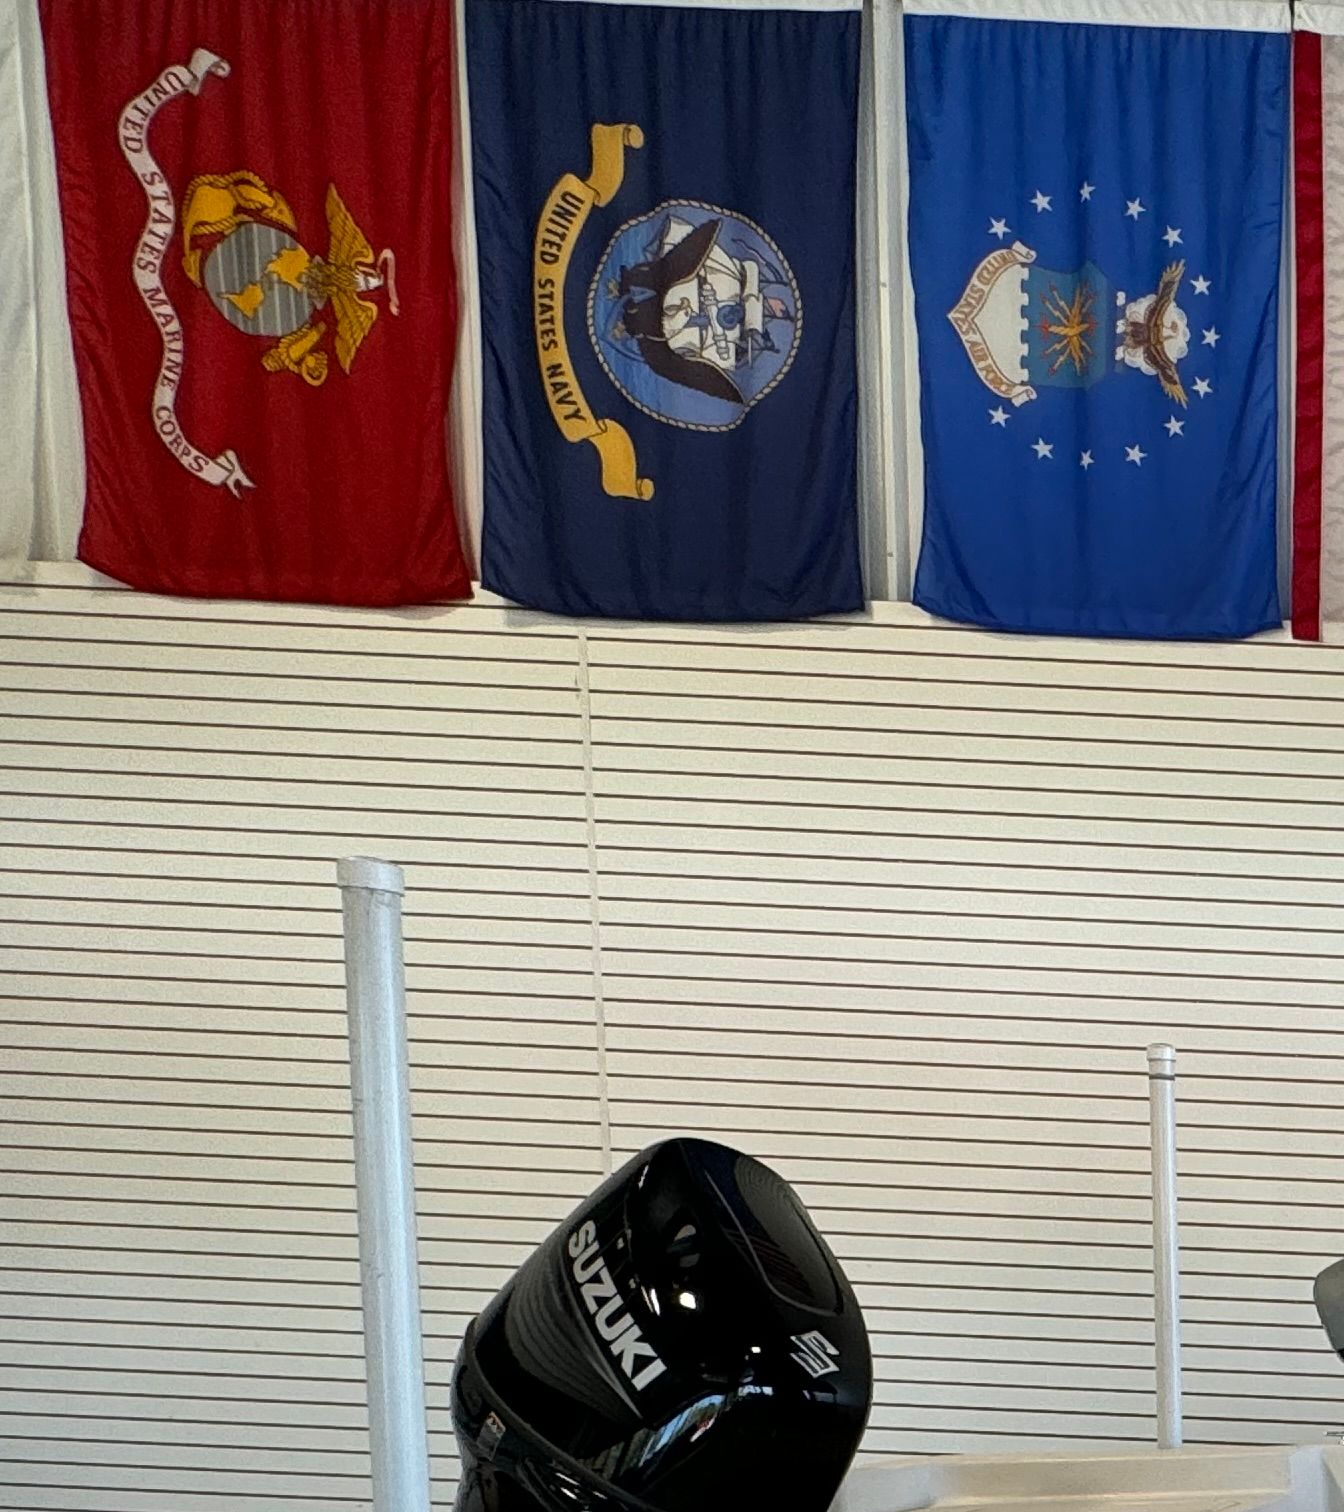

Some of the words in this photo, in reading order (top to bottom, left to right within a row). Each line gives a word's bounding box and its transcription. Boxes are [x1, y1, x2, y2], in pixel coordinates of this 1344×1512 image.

[122, 70, 188, 154] UNITED
[136, 170, 172, 274] STATES
[540, 190, 585, 266] UNITED
[143, 286, 181, 391] MARINE
[537, 278, 558, 353] STATES
[546, 362, 587, 422] NAVY
[156, 405, 210, 473] CORPS
[568, 1218, 668, 1393] SUZUKI
